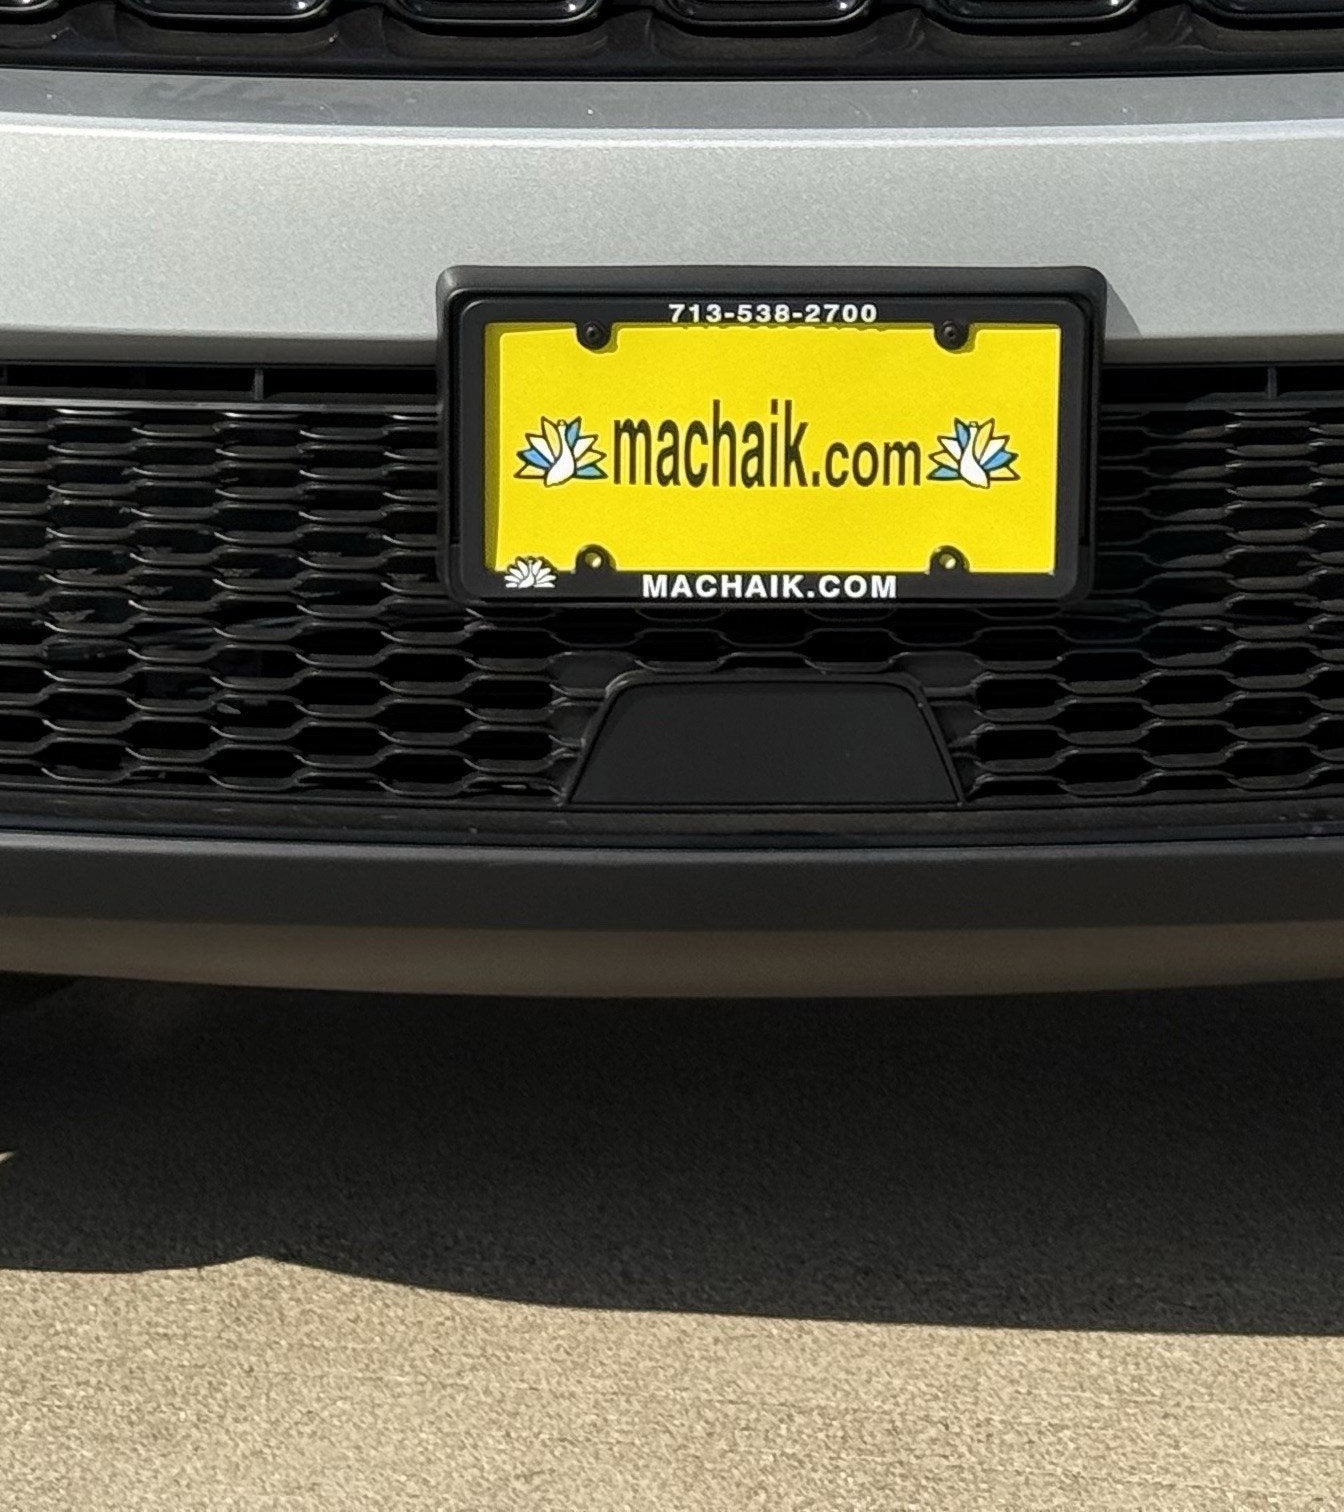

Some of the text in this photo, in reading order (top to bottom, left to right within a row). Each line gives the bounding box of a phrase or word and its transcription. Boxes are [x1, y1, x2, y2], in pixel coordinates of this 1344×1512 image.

[668, 303, 878, 324] 713-538-2700
[612, 398, 922, 489] machaik.com
[641, 574, 898, 600] MACHAIK.COM
